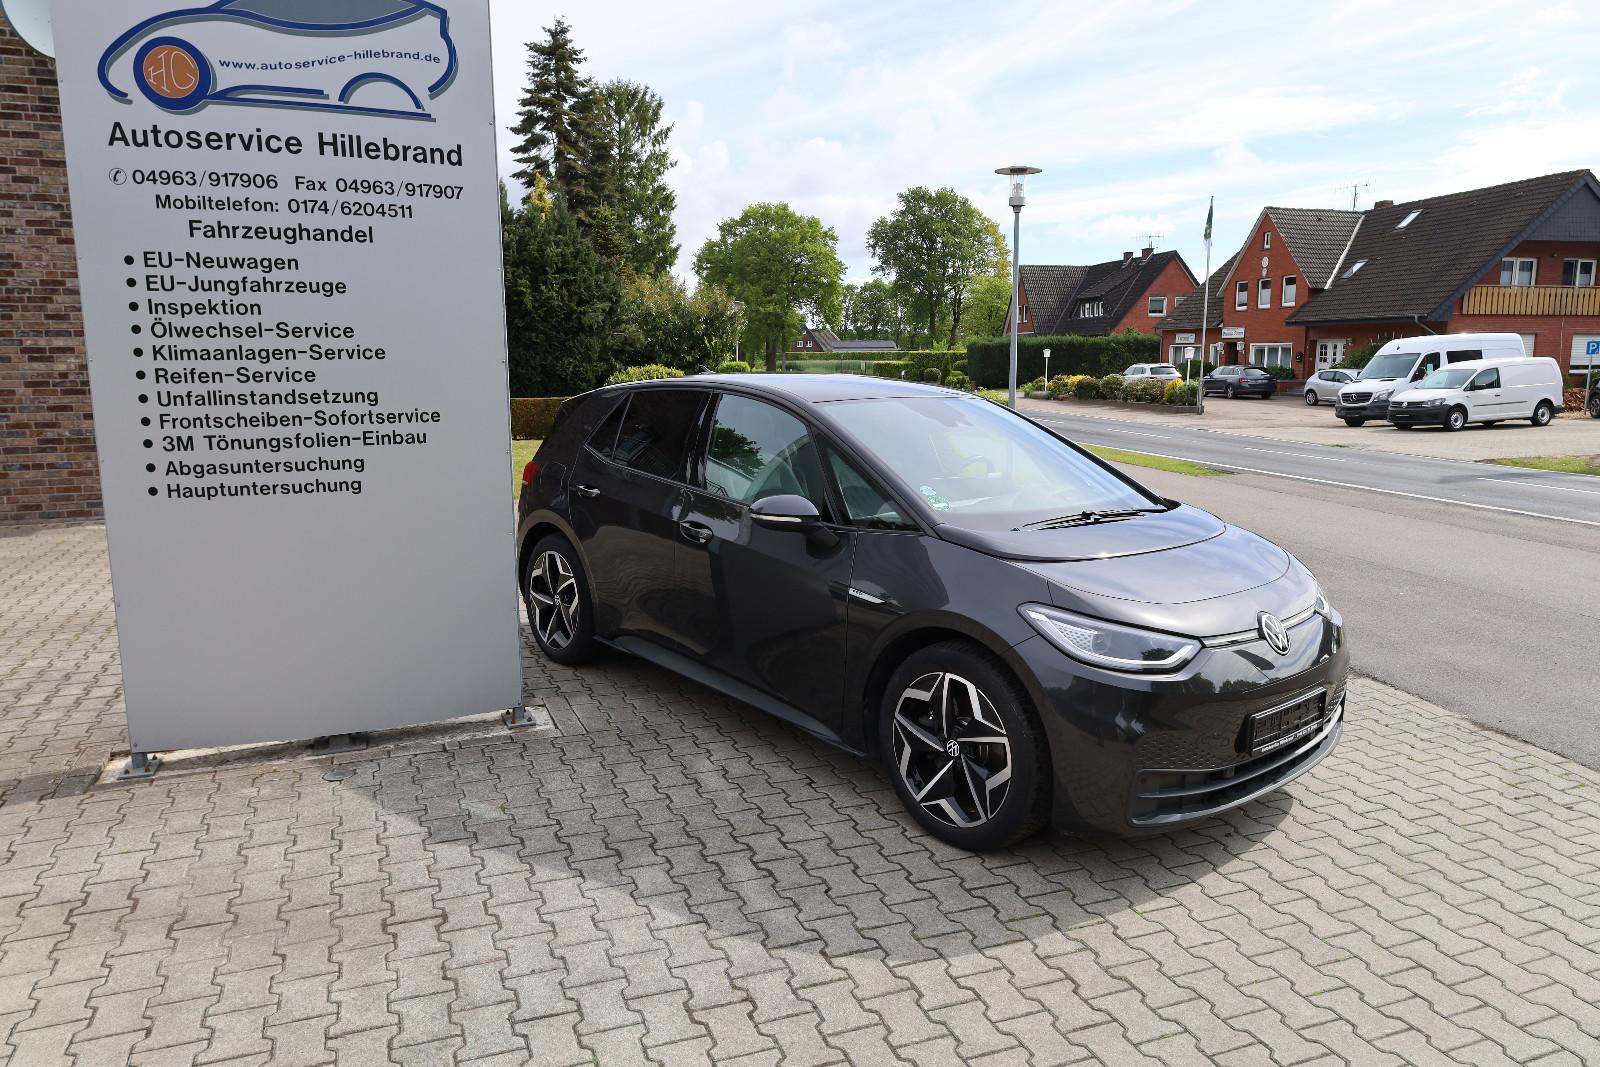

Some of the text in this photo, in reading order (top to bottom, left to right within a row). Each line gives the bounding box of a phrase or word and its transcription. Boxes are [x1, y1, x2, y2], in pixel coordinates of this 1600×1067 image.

[218, 49, 441, 71] www.autoservice-hillebrand.de
[107, 121, 463, 167] Autoservice Hillebrand
[131, 169, 464, 200] 04963/917906 Fax 04963/917907
[155, 193, 413, 219] Mobiltelefon: 0174/6204511
[188, 219, 374, 245] Fahrzeughandel
[143, 250, 300, 273] EU-Neuwagen
[145, 275, 348, 297] EU-Jungfahrzeuge
[147, 298, 263, 317] Inspektion
[150, 317, 355, 339] Ölwechsel-Service
[152, 343, 386, 365] Klimaanlagen-Service
[154, 366, 317, 385] Reifen-Service
[156, 388, 379, 408] Unfallinstandsetzung
[159, 407, 441, 430] Frontscheiben-Sofortservice
[162, 430, 428, 453] 3M Tönungsfolien-Einbau
[165, 456, 366, 478] Abgasuntersuchung
[166, 478, 362, 501] Hauptuntersuchung
